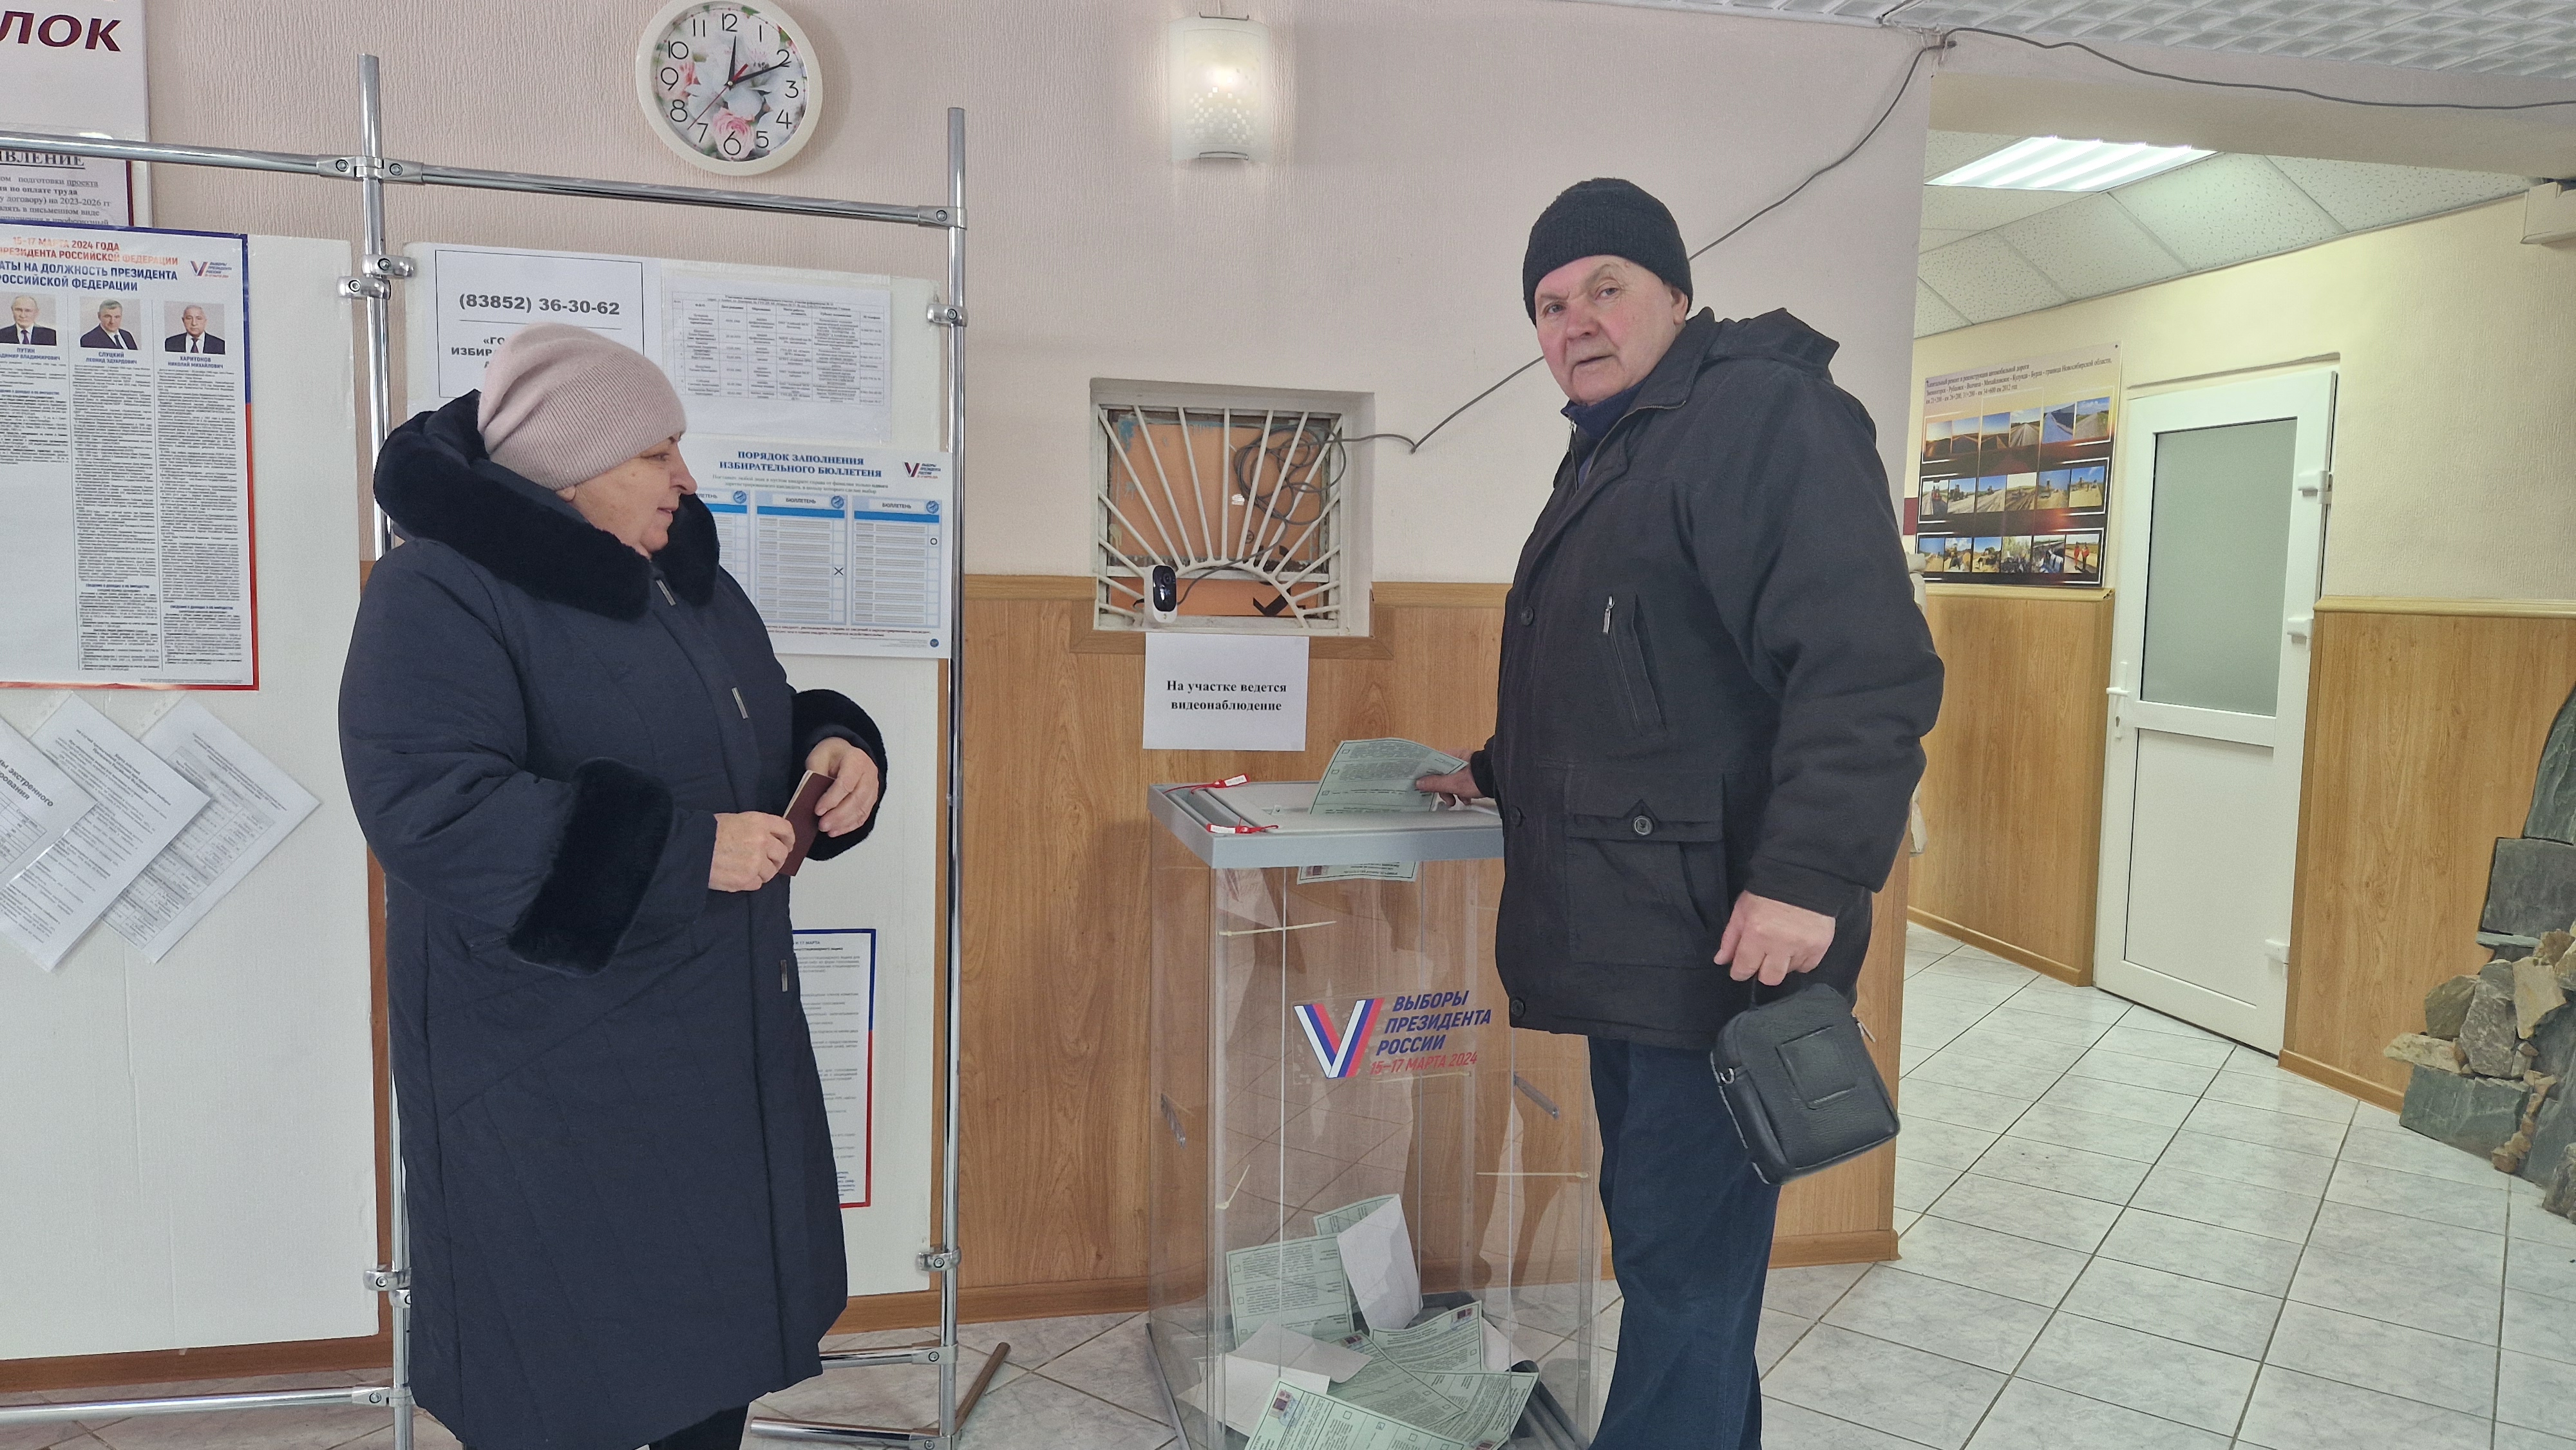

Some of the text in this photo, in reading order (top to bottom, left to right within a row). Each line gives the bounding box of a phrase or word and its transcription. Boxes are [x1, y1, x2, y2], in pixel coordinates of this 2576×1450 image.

[693, 19, 705, 37] 11
[722, 13, 737, 32] 12
[668, 41, 689, 59] 10
[777, 50, 790, 68] 2
[661, 67, 678, 91] 9
[785, 80, 799, 98] 3
[670, 99, 688, 122] 8
[776, 109, 792, 129] 4
[697, 123, 708, 143] 7
[756, 131, 769, 148] 5
[723, 131, 741, 155] 6
[0, 150, 84, 166] ВЛЕНИЕ
[6, 196, 47, 205] договору)
[60, 198, 101, 207] 2023-2026
[30, 207, 79, 215] письменном
[71, 240, 93, 249] 2024
[96, 241, 120, 251] ГОДА
[59, 250, 120, 261] РОССИЙСКОЙ
[122, 254, 178, 265] ФЕДЕРАЦИИ
[24, 262, 38, 272] НА
[41, 263, 108, 276] ДОЛЖНОСТЬ
[111, 267, 178, 281] ПРЕЗИДЕНТА
[71, 278, 138, 292] ФЕДЕРАЦИИ
[459, 293, 620, 315] (83852) 36-30-62
[737, 451, 864, 465] ПОРЯДОК ЗАПОЛНЕНИЯ
[719, 461, 882, 478] ИЗБИРАТЕЛЬНОГО БЮЛЛЕТЕНЯ
[1166, 680, 1287, 693] На участке ведется
[1171, 700, 1282, 711] видеонаблюдение
[8, 767, 53, 807] экстренного
[1392, 990, 1470, 1012] ВЫБОРЫ
[1384, 1009, 1492, 1034] ПРЕЗИДЕНТА
[1376, 1034, 1446, 1056] РОССИИ
[1405, 1054, 1446, 1072] МАРТА
[1448, 1051, 1477, 1068] 2024
